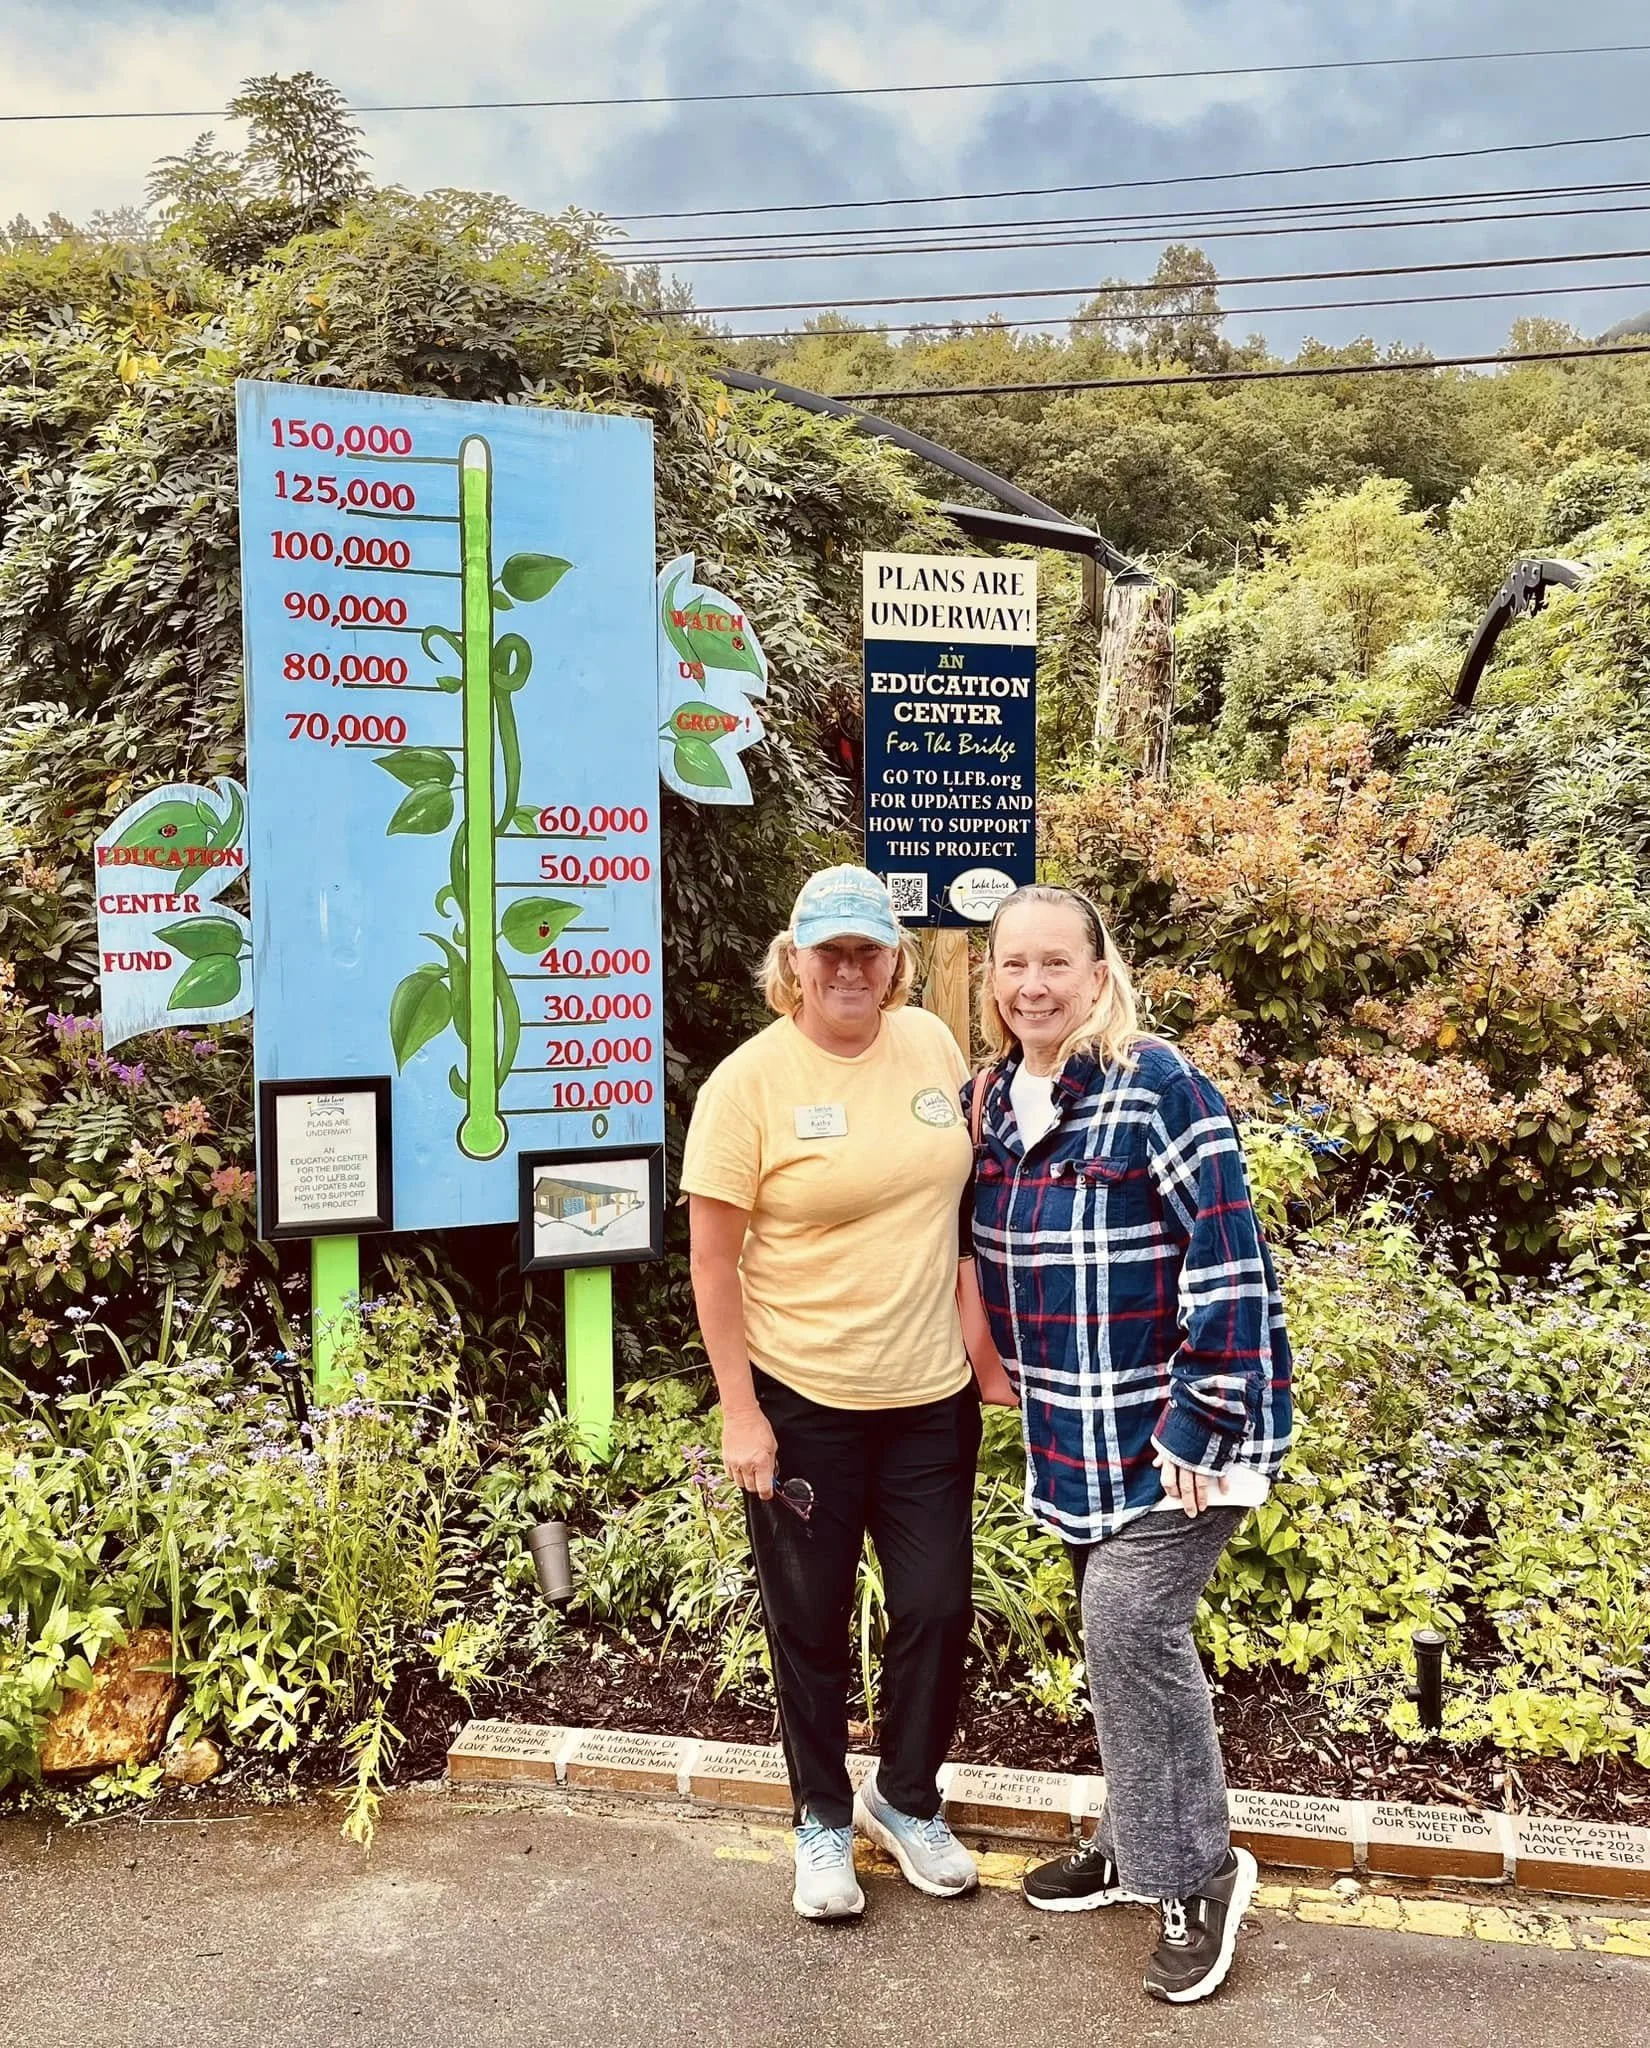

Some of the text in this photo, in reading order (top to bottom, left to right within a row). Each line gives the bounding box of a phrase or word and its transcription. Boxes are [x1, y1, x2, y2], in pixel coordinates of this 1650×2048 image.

[271, 418, 412, 456] 150,000
[274, 470, 415, 511] 125,000
[271, 531, 411, 568] 100,000
[878, 566, 1024, 596] PLANS ARE
[283, 592, 407, 627] 90,000
[871, 601, 1030, 632] UNDERWAY!
[670, 610, 744, 632] WATCH
[283, 653, 408, 687] 80,000
[678, 661, 705, 680] US
[937, 654, 965, 669] AN
[870, 672, 1030, 698] EDUCATION
[893, 701, 1003, 725] CENTER
[285, 713, 406, 746] 70,000
[886, 731, 1017, 763] For The Bridge
[882, 769, 1022, 790] GO TO LLFB.org
[870, 793, 1033, 811] FOR UPDATES AND
[539, 806, 649, 837] 60,000
[869, 817, 1031, 834] HOW TO SUPPORT
[96, 846, 243, 868] EDUCATION
[886, 840, 1017, 857] THIS PROJECT.
[539, 855, 650, 885] 50,000
[99, 893, 201, 914] CENTER
[103, 950, 172, 972] FUND
[539, 948, 650, 979] 40,000
[544, 993, 651, 1022] 30,000
[546, 1037, 651, 1069] 20,000
[553, 1080, 652, 1110] 10,000
[307, 1119, 350, 1128] PLANS ARE
[592, 1113, 608, 1139] 0
[290, 1156, 336, 1165] EDUCATION
[297, 1163, 361, 1174] FOR THE BRIDGE
[294, 1181, 366, 1193] FOR UPDATES AND
[300, 1175, 312, 1183] GO
[315, 1174, 325, 1182] TO
[295, 1190, 365, 1202] HOW TO SUPPORT
[303, 1202, 320, 1210] THIS
[469, 1724, 512, 1735] MADDIE
[491, 1745, 520, 1753] MOM
[495, 1736, 548, 1747] SUNSHINE
[580, 1742, 656, 1756] MIKE LUMPKIN
[607, 1735, 658, 1746] MEMORY
[661, 1740, 677, 1748] OF
[586, 1753, 646, 1766] GRACIOUS
[648, 1759, 677, 1768] MAN
[703, 1754, 757, 1766] JULIANA
[704, 1765, 734, 1774] 2001
[958, 1768, 1068, 1786] LOVE NEVER DIES
[1000, 1782, 1041, 1794] KIEFER
[1235, 1794, 1340, 1813] DICK AND JOAN
[1248, 1807, 1326, 1822] MCCALLUM
[1377, 1806, 1485, 1824] REMEMBERING
[1230, 1815, 1347, 1836] ALWAYS GIVING
[1372, 1817, 1493, 1836] OUR SWEET BOY
[1529, 1822, 1630, 1840] HAPPY 65TH
[1416, 1832, 1453, 1843] JUDE
[1519, 1832, 1646, 1852] NANCY 2023
[1524, 1844, 1645, 1864] LOVE THE SIBS
